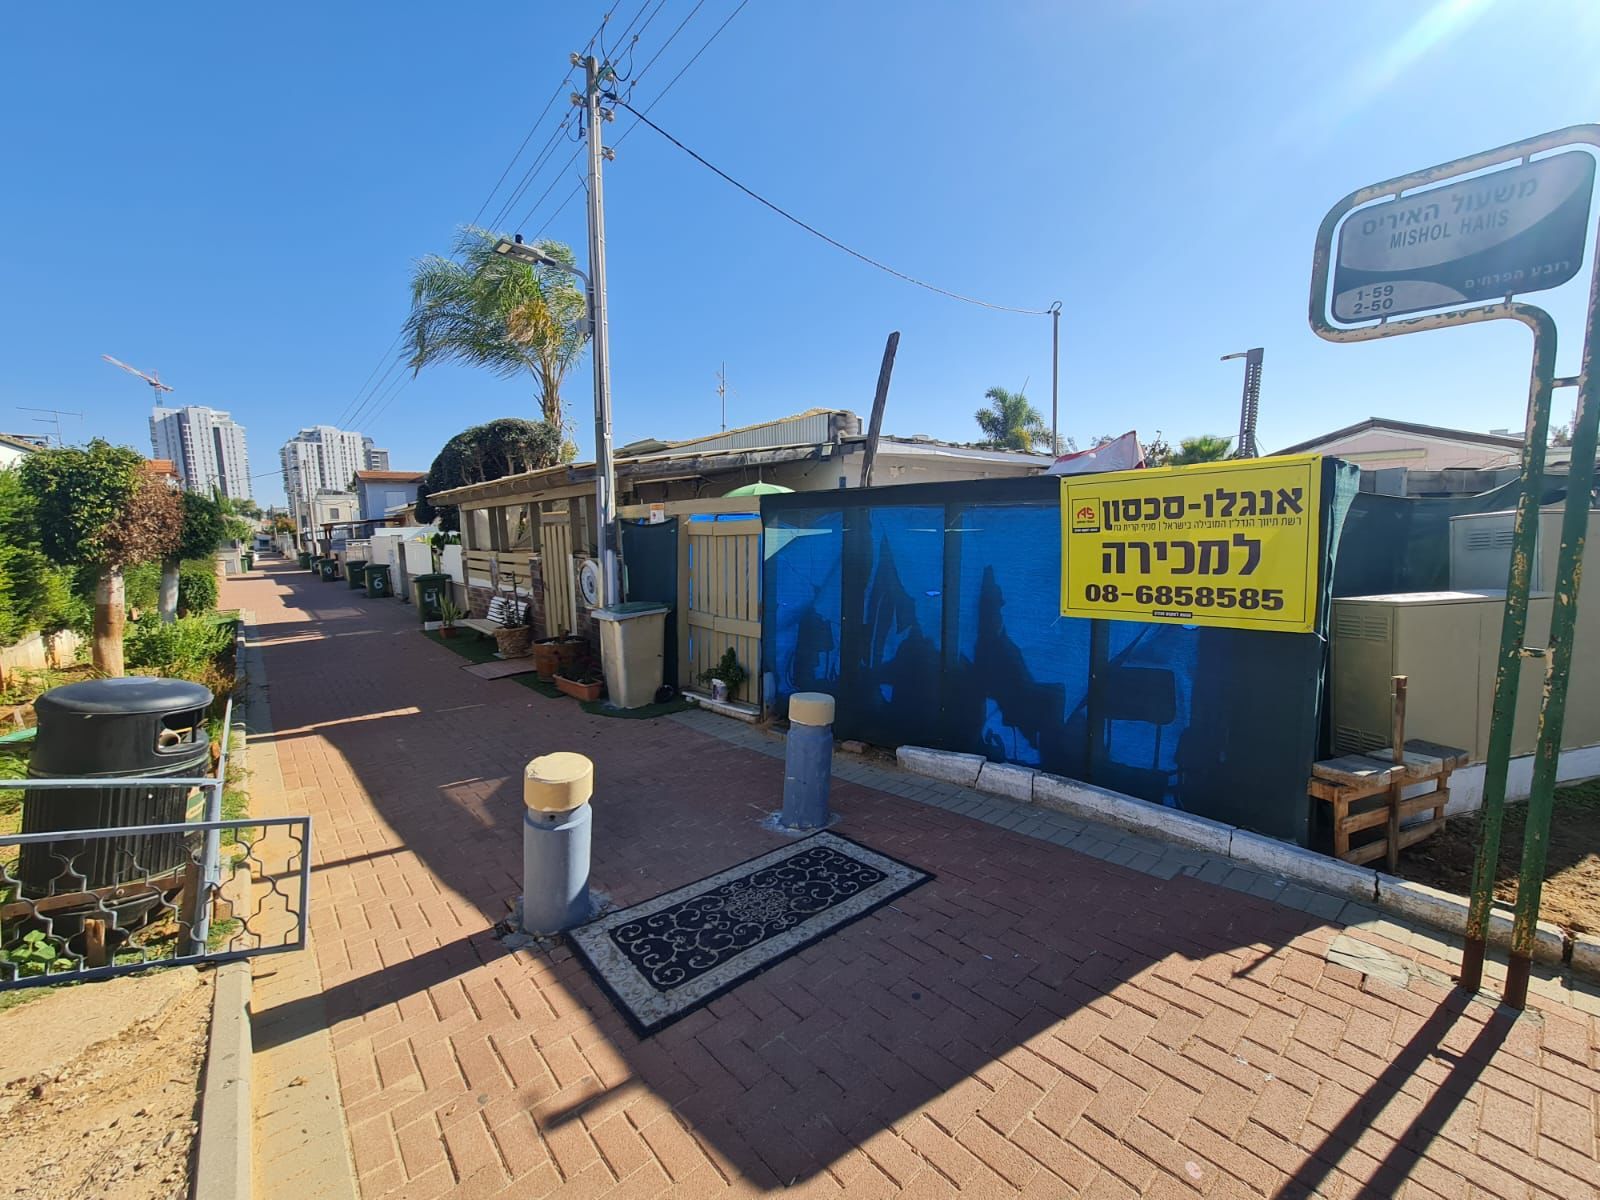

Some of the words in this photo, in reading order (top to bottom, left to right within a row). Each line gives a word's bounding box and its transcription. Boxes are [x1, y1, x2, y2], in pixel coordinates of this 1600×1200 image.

[1451, 179, 1537, 215] משעול
[1362, 203, 1440, 235] האירים
[1390, 222, 1451, 250] MISHOL
[1531, 261, 1570, 277] רובע
[1464, 270, 1525, 289] הפרחים
[1357, 285, 1394, 301] 1-59
[1352, 298, 1394, 314] 2-50
[1077, 507, 1095, 519] AS
[1102, 488, 1303, 531] אנגלו-סכסון
[1123, 523, 1140, 532] קרית
[1141, 523, 1156, 532] סניף
[1163, 521, 1191, 530] בישראל
[1194, 520, 1226, 529] המובילה
[1258, 518, 1279, 528] תיווך
[1281, 516, 1302, 526] רשת
[1102, 533, 1261, 576] למכירה
[373, 577, 383, 589] 6
[425, 592, 438, 607] 4
[1085, 583, 1284, 611] 08-6858585
